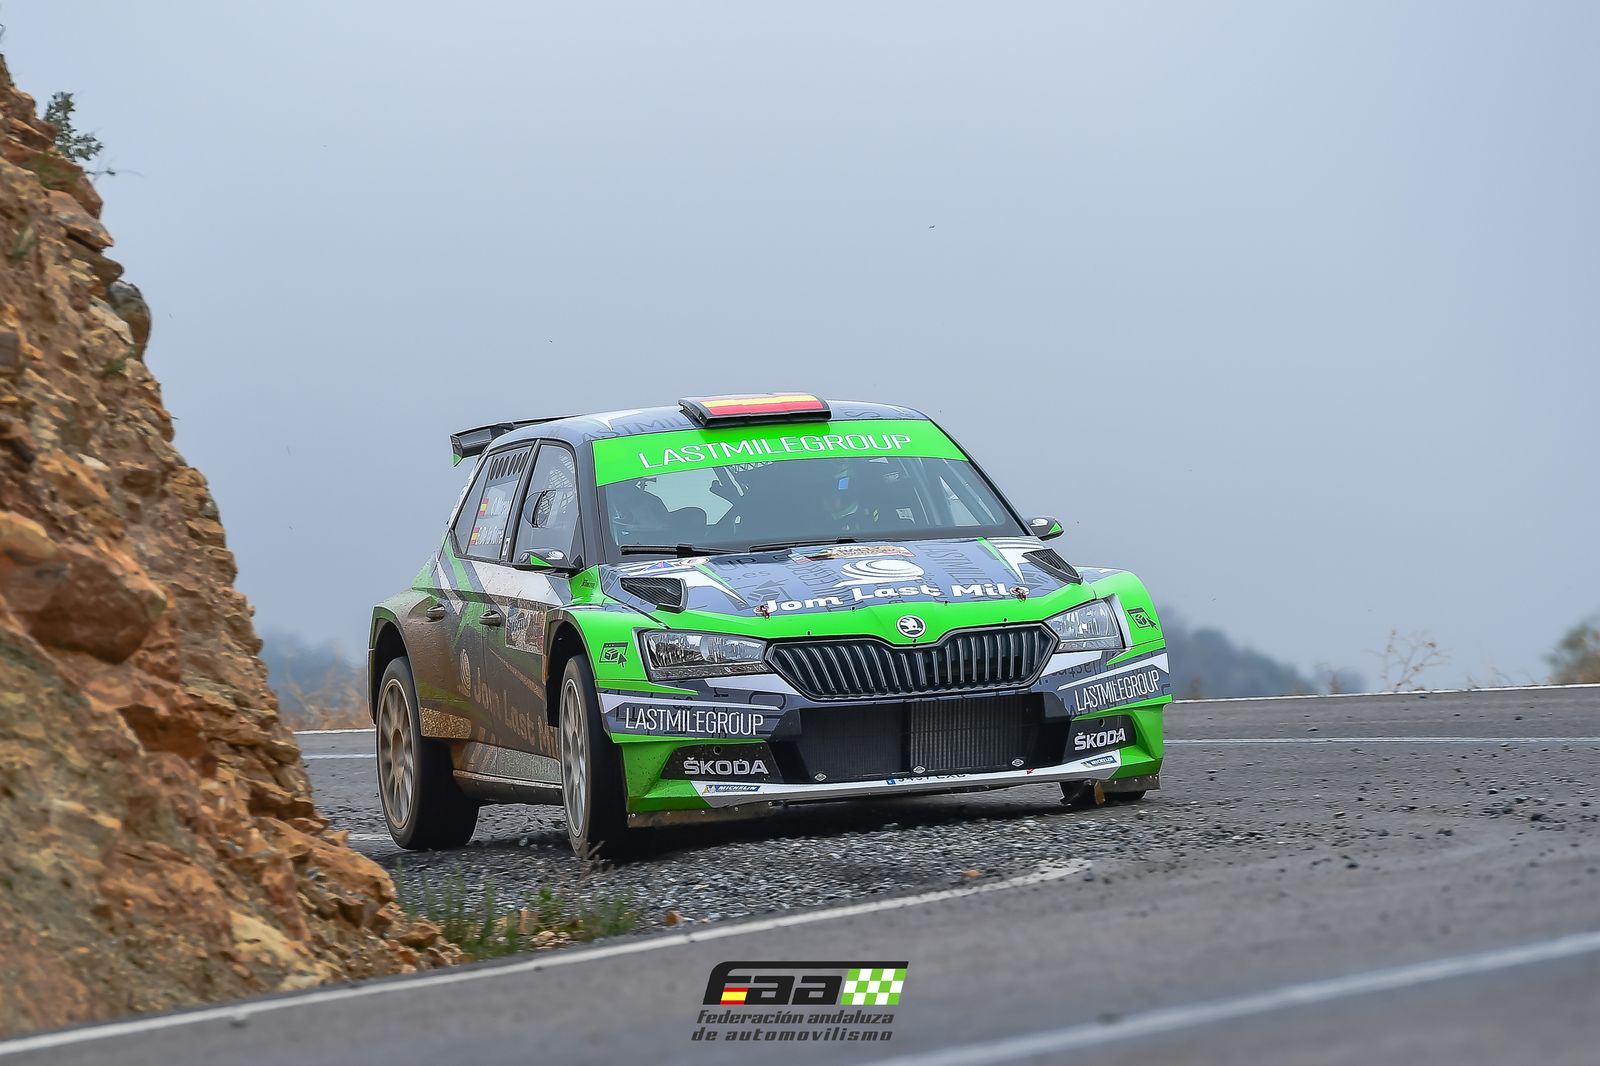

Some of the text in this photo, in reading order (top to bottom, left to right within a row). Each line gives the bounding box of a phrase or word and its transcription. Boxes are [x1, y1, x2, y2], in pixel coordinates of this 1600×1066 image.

[638, 433, 911, 469] LASTMILEGROUP
[753, 596, 843, 614] Jom
[851, 583, 944, 601] Last
[1074, 669, 1160, 712] LASTMILEGROUP
[625, 707, 764, 735] LASTMILEGROUP
[1074, 727, 1126, 751] ŠKODA
[683, 757, 769, 775] ŠKODA
